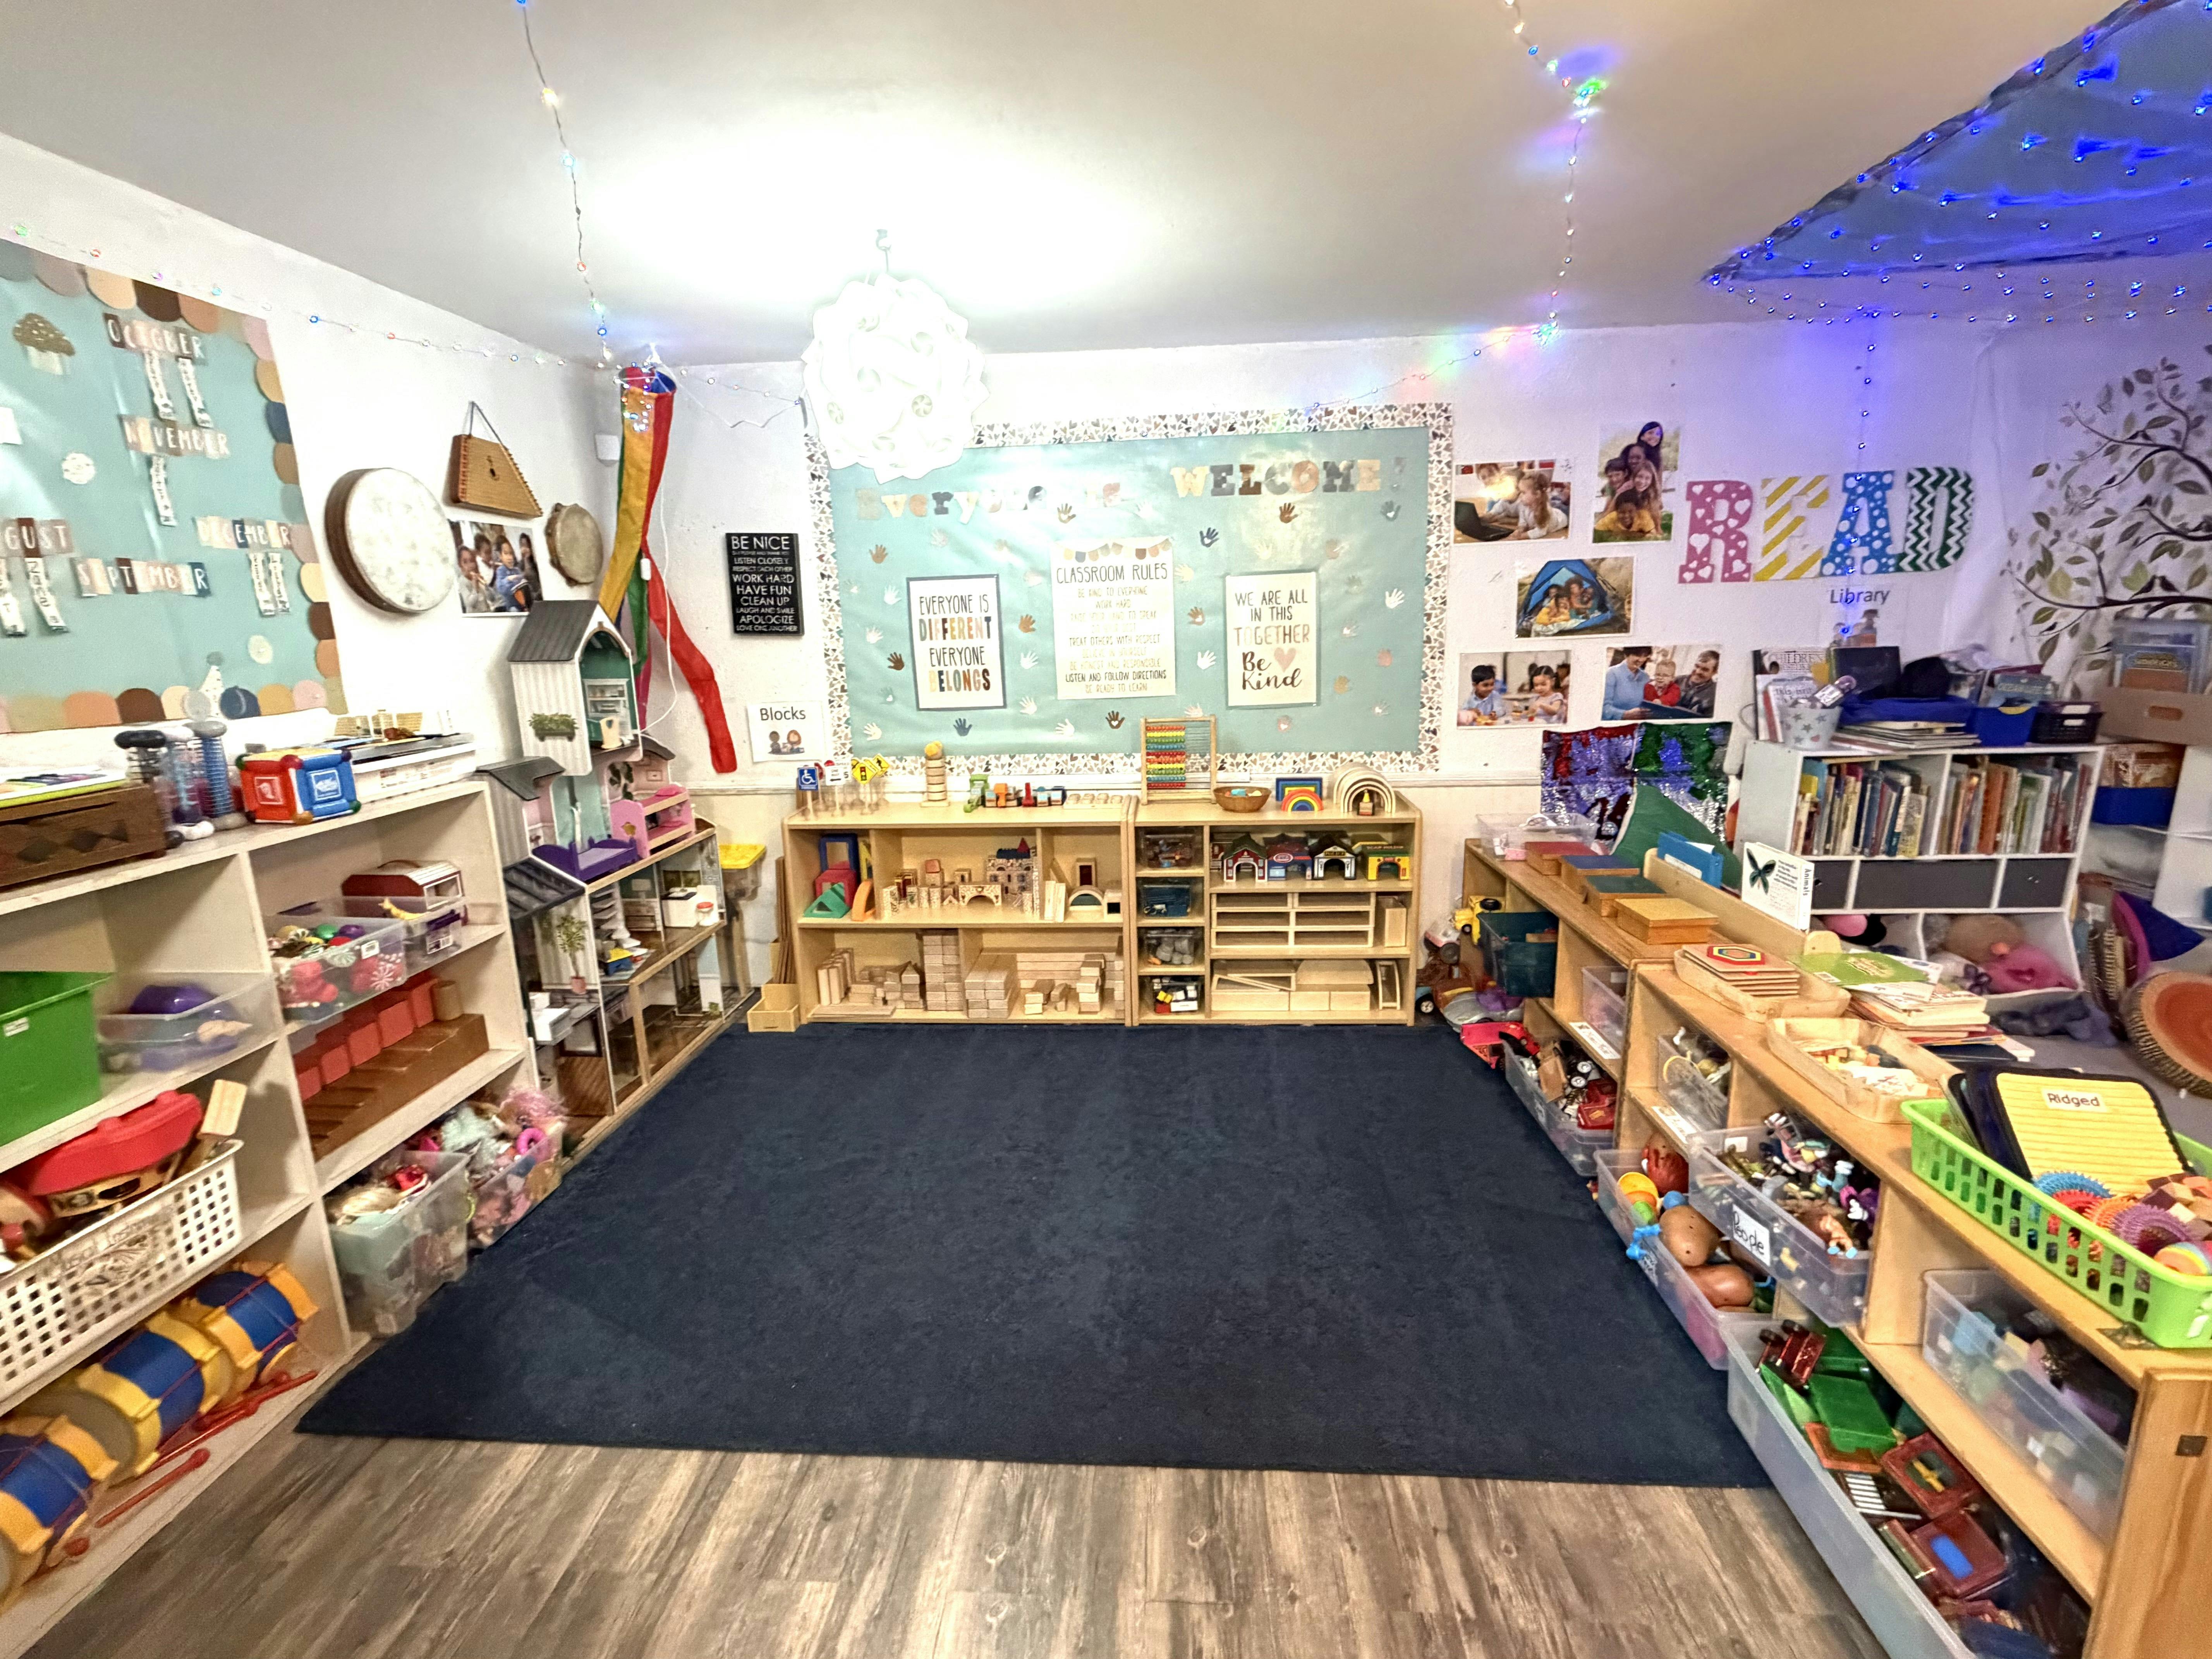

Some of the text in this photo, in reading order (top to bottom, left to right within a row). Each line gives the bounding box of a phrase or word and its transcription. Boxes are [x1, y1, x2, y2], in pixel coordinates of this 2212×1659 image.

[126, 422, 229, 455] NOVEMBER
[1678, 467, 1975, 584] READ
[731, 536, 790, 550] BE NICE
[77, 565, 208, 591] SEPTEMBER
[732, 574, 795, 583] WORK HARD
[1057, 563, 1167, 584] CLASSROOM RULES
[737, 585, 792, 595] HAVE FUN
[1106, 587, 1114, 596] TO
[1235, 589, 1309, 606] WE ARE ALL
[1831, 588, 1890, 606] Library
[740, 596, 790, 606] CLEAN UP
[919, 594, 989, 615] EVERYONE IS
[739, 615, 794, 624] APOLOGIZE
[1250, 606, 1293, 622] IN THIS
[919, 617, 992, 641] DIFFERENT
[1233, 624, 1310, 646] TOGETHER
[1070, 634, 1160, 646] TREAT OTHERS WITH RESPECT
[929, 646, 986, 667] EVERYONE
[1242, 651, 1271, 672] Be
[929, 668, 991, 692] BELONGS
[1065, 670, 1166, 682] LISTEN AND FOLLOW DIRECTIONS
[1242, 668, 1303, 690] Kind
[1085, 683, 1147, 694] BE READY TO LEARN
[761, 706, 806, 721] Blocks
[1803, 869, 1812, 896] Animals
[2047, 1093, 2100, 1107] Ridged
